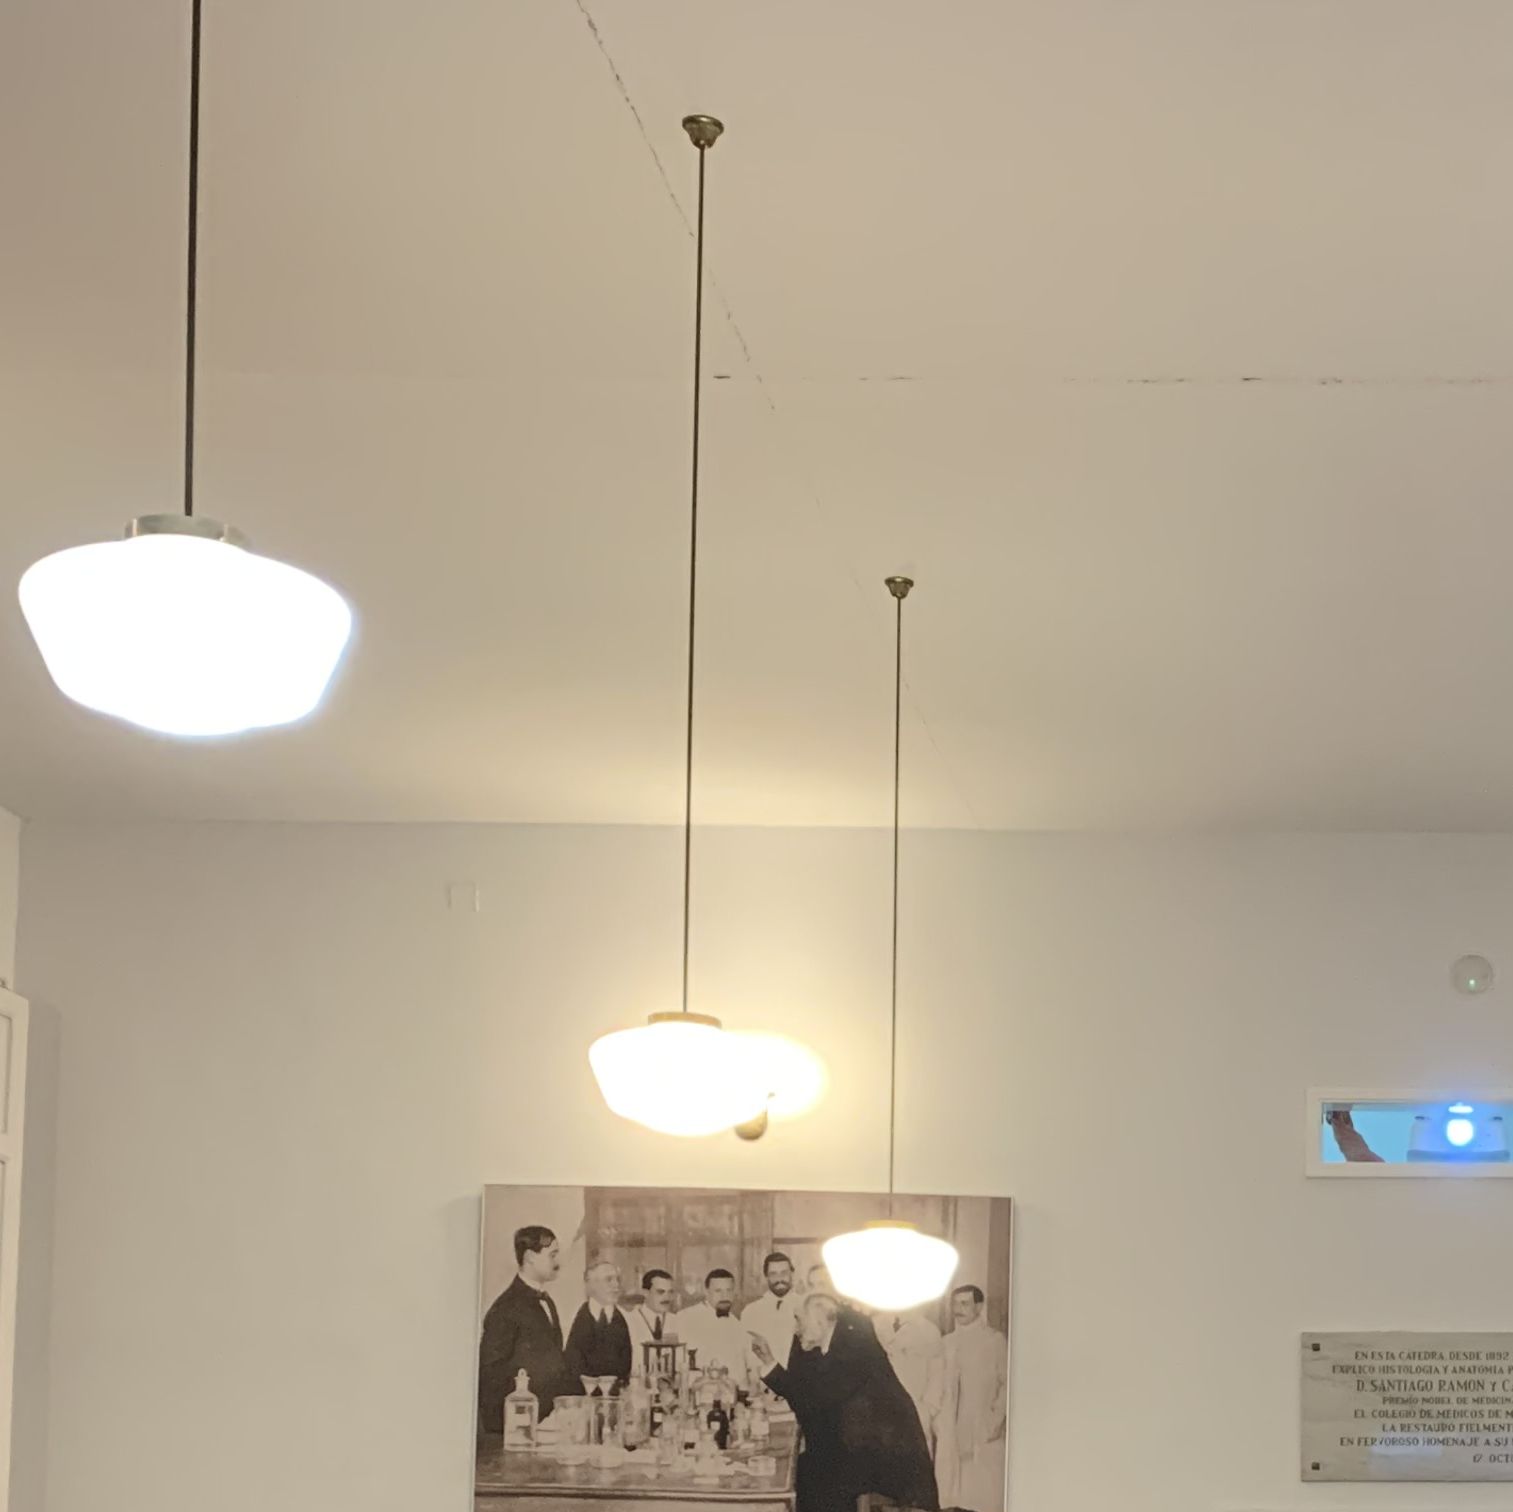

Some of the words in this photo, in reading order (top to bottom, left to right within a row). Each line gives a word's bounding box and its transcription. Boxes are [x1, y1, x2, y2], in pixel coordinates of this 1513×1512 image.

[1354, 1351, 1368, 1361] EN
[1370, 1351, 1396, 1361] ESTA
[1449, 1351, 1483, 1361] DESDE
[1485, 1351, 1510, 1361] 1892
[1441, 1365, 1449, 1375] Y
[1356, 1380, 1368, 1393] D.
[1369, 1380, 1434, 1393] SANTIAGO
[1489, 1380, 1497, 1393] Y
[1381, 1396, 1419, 1405] PREMIO
[1420, 1396, 1452, 1405] NOBEL
[1455, 1396, 1469, 1405] DE
[1353, 1409, 1366, 1420] EL
[1370, 1409, 1417, 1420] COLEGIO
[1418, 1409, 1433, 1420] DE
[1487, 1409, 1502, 1420] DE
[1381, 1422, 1397, 1433] LA
[1339, 1436, 1355, 1447] EN
[1356, 1436, 1420, 1447] FERVOROSO
[1421, 1436, 1480, 1447] HOMENAJE
[1483, 1436, 1491, 1447] A
[1493, 1436, 1509, 1447] SU
